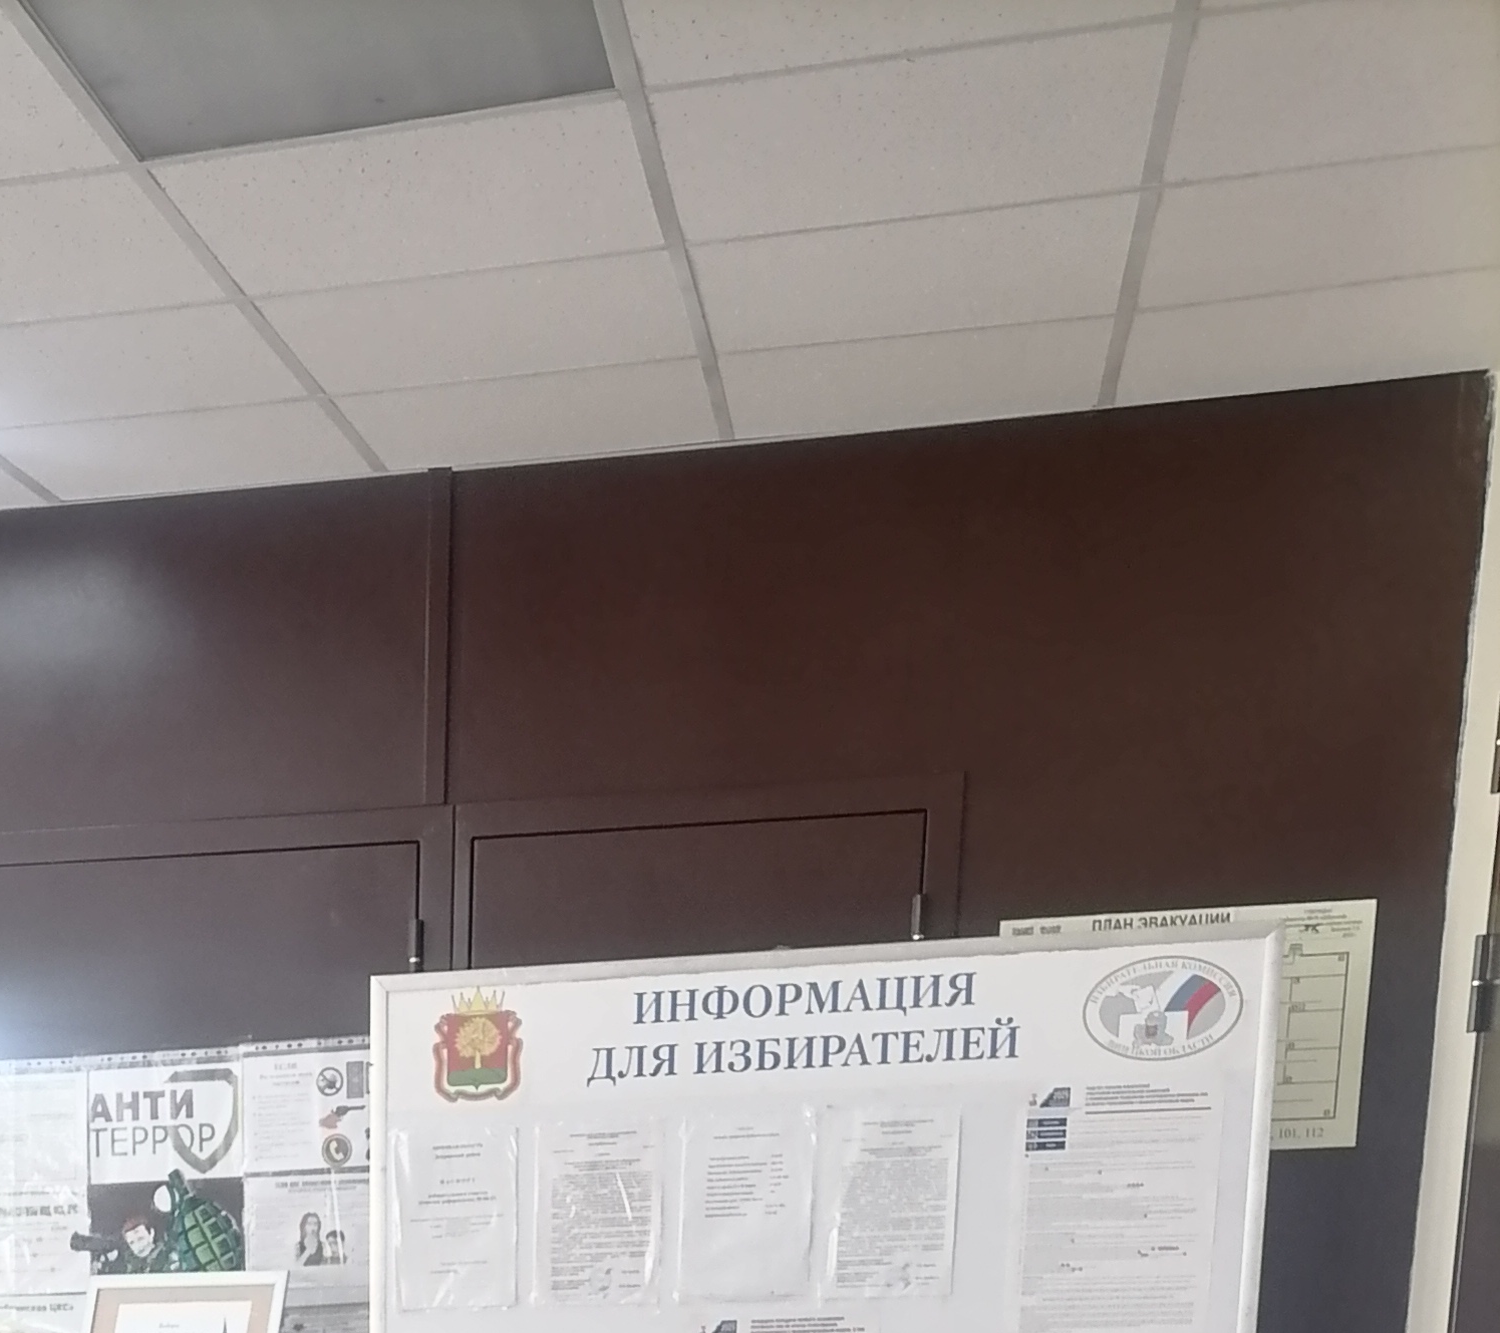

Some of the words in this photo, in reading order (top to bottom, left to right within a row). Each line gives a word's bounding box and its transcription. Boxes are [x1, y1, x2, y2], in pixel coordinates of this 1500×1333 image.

[1092, 917, 1134, 932] ПЛАН
[1137, 912, 1231, 931] ЭВАКУАЦИИ
[633, 972, 977, 1024] ИНФОРМАЦИЯ
[587, 1042, 679, 1087] ДЛЯ
[693, 1017, 1021, 1075] ИЗБИРАТЕЛЕЙ
[91, 1089, 194, 1123] АНТИ
[91, 1123, 216, 1158] ТЕРРОР
[1305, 1127, 1324, 1138] 112
